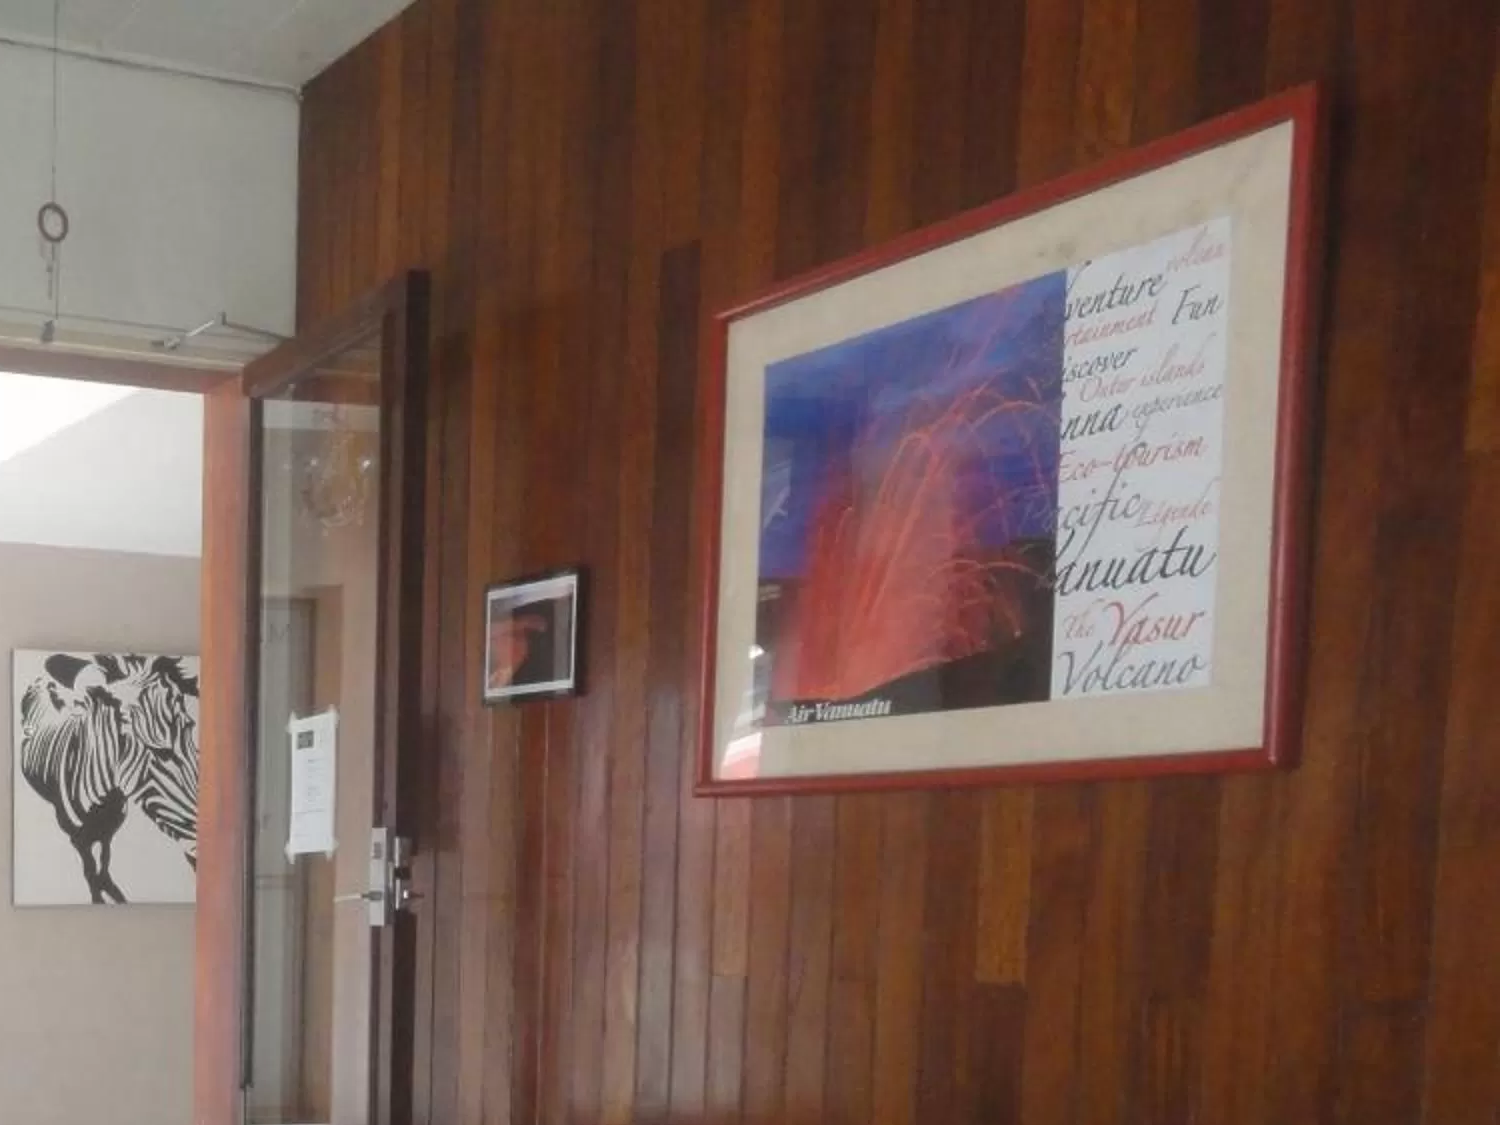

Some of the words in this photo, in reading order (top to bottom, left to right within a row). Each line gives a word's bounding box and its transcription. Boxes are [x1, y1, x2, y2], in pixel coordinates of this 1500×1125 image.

[1172, 286, 1223, 325] Fun
[1103, 592, 1206, 648] Yasur
[1057, 640, 1208, 696] Volcano
[786, 705, 814, 724] Air
[815, 697, 892, 722] Vanuatu
